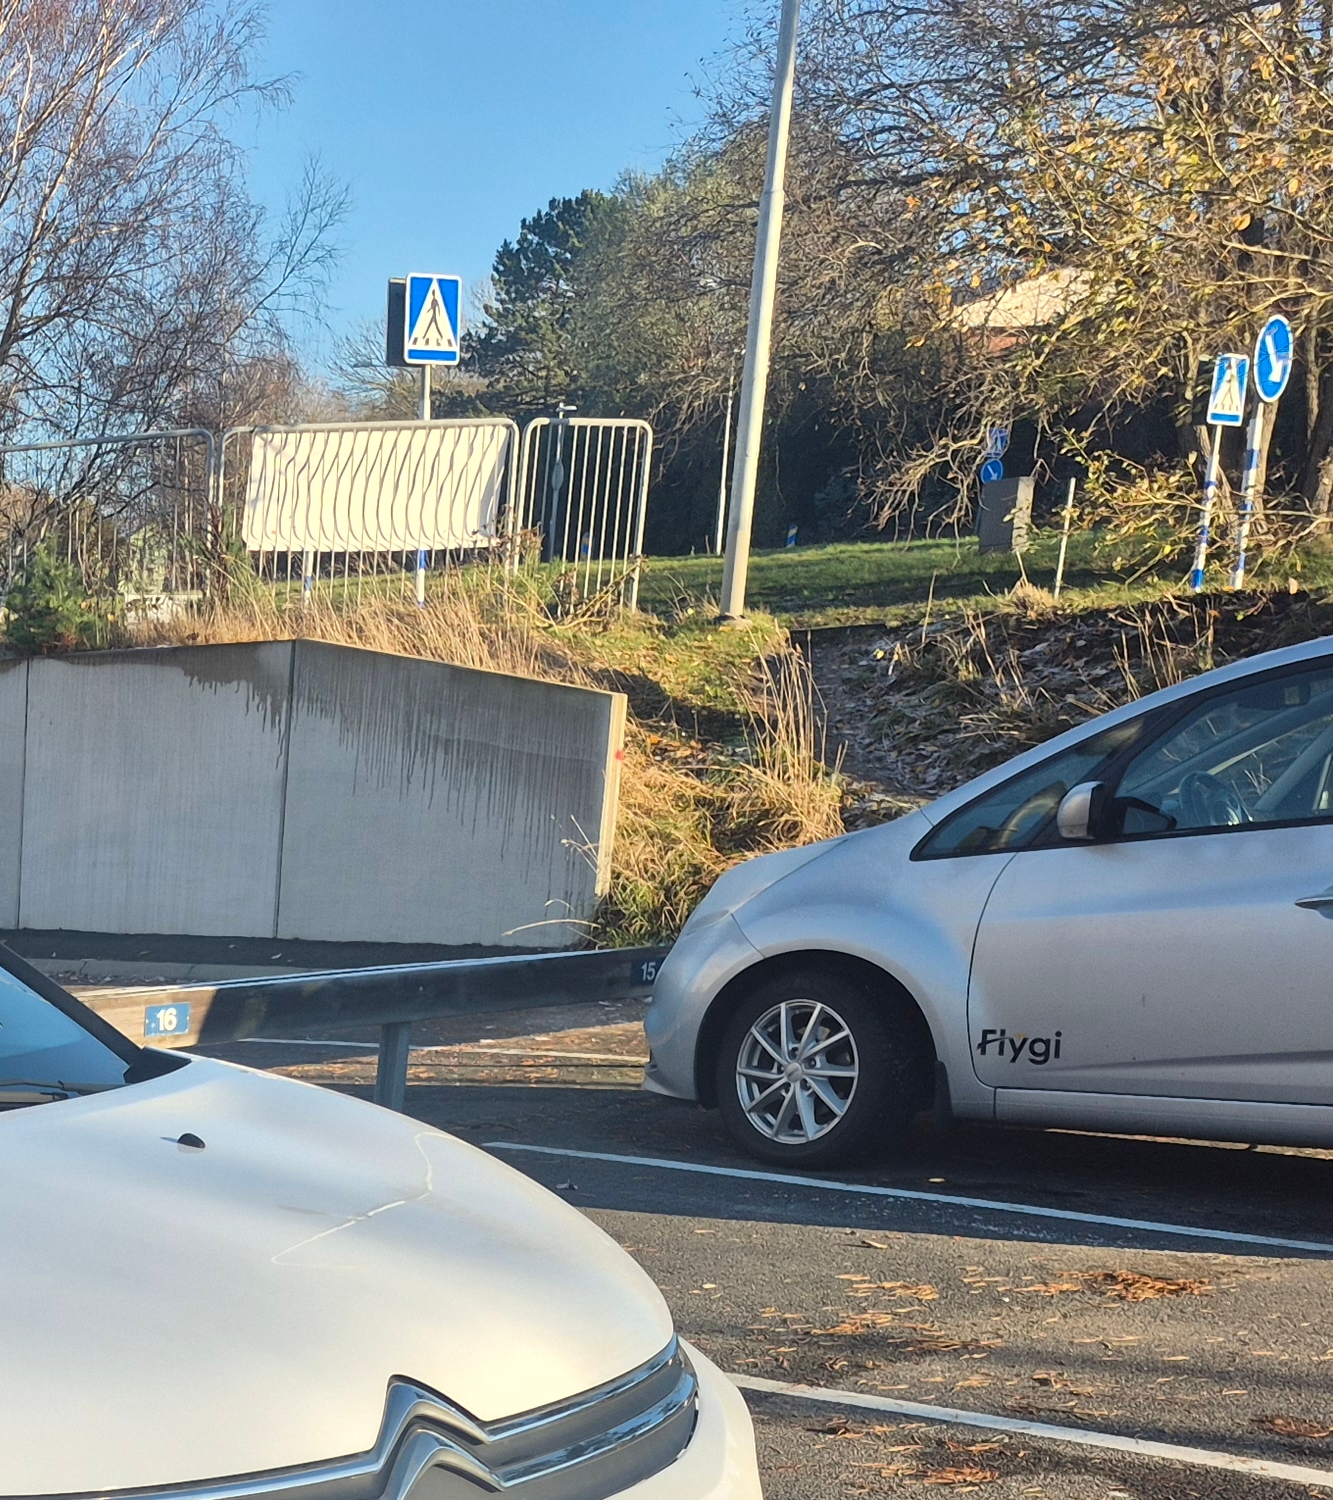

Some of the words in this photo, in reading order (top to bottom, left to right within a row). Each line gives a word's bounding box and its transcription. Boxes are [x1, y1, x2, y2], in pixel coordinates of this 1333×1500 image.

[641, 961, 656, 981] 15
[156, 1007, 177, 1031] 16
[977, 1028, 1062, 1065] Flygi
